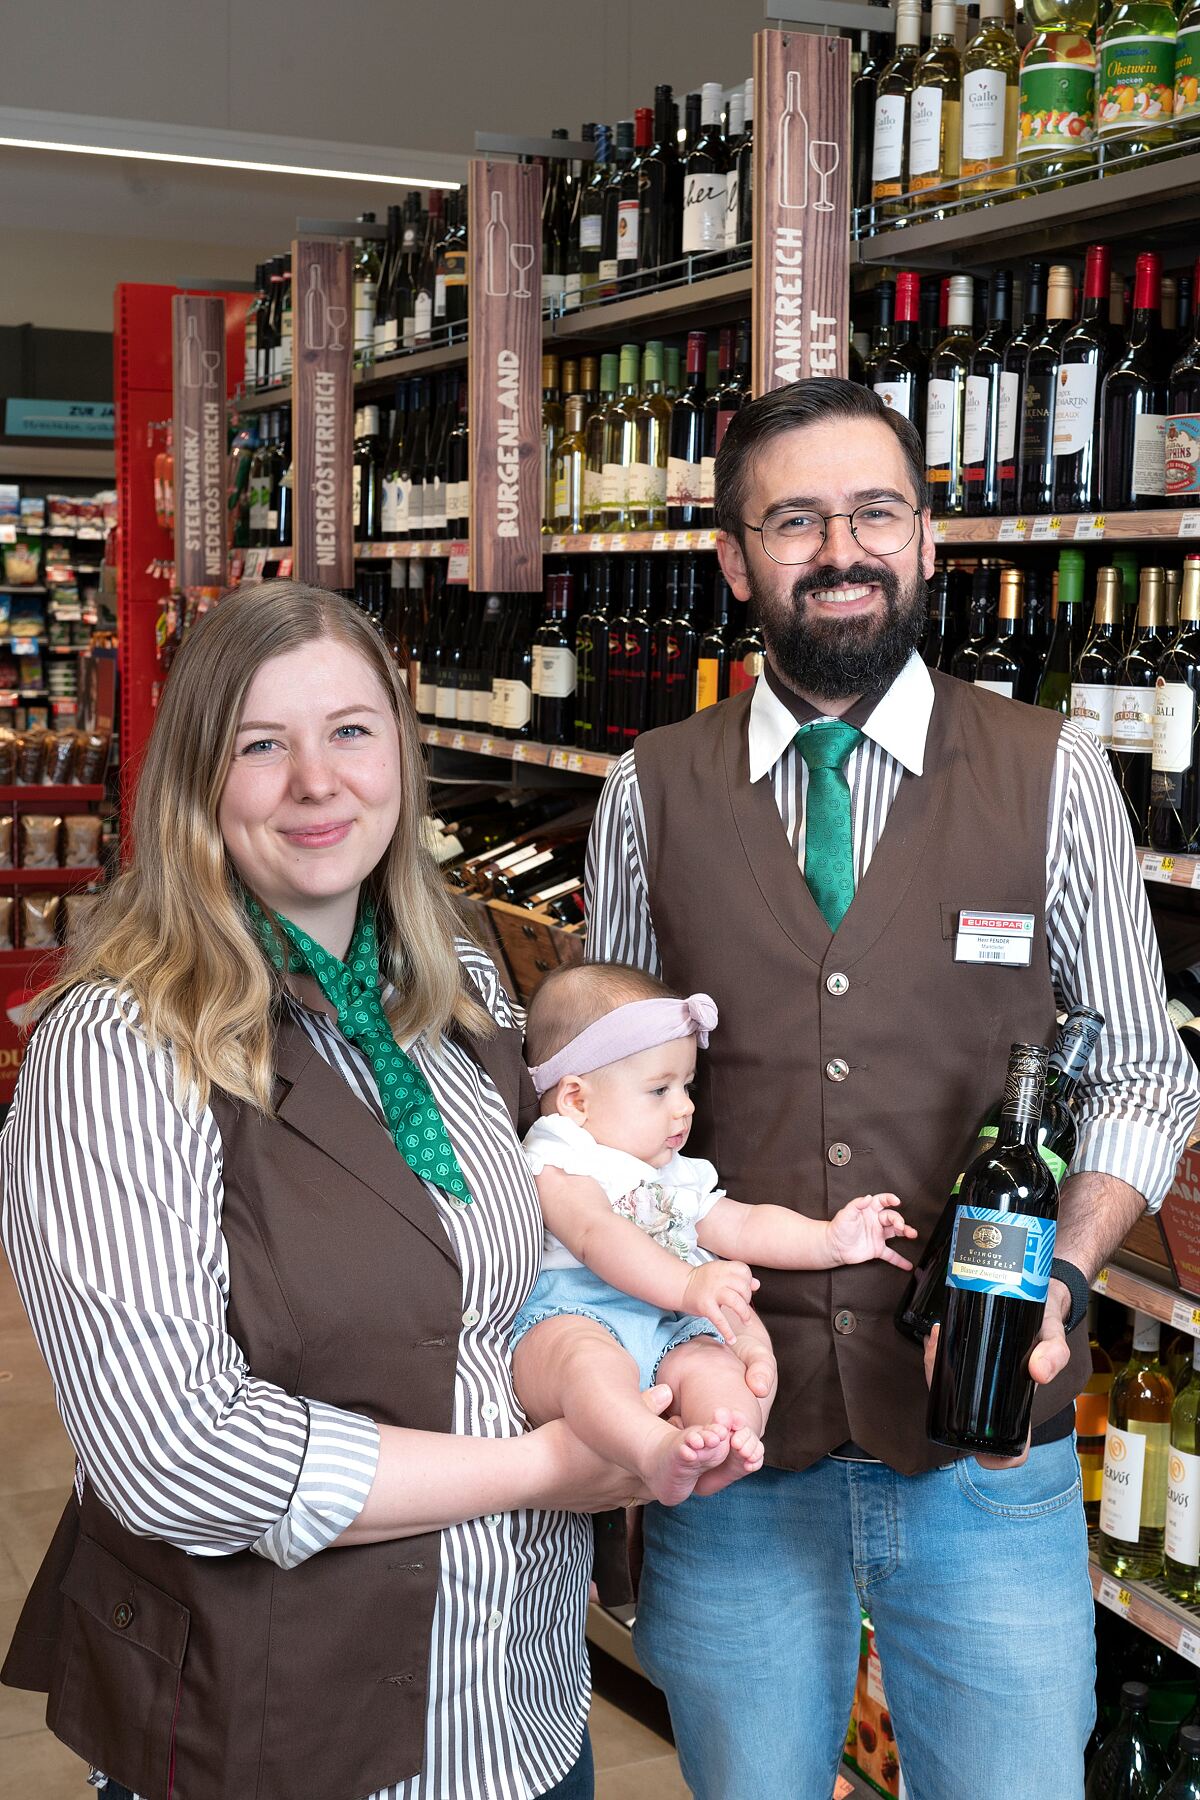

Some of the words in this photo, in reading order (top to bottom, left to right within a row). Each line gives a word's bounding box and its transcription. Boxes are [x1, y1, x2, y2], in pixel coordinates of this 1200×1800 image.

[1107, 60, 1157, 78] Obstwein
[1117, 77, 1143, 85] trocken
[968, 91, 998, 103] Gallo
[497, 349, 520, 539] BURGENLAND
[312, 371, 337, 566] NIEDERÖSTERREICH
[184, 426, 202, 551] STEIERMARK/
[202, 402, 221, 576] NIEDERÖSTERREICH
[1125, 711, 1137, 719] DEL
[967, 919, 1022, 929] EUROSPAR
[960, 1265, 978, 1275] Blauer
